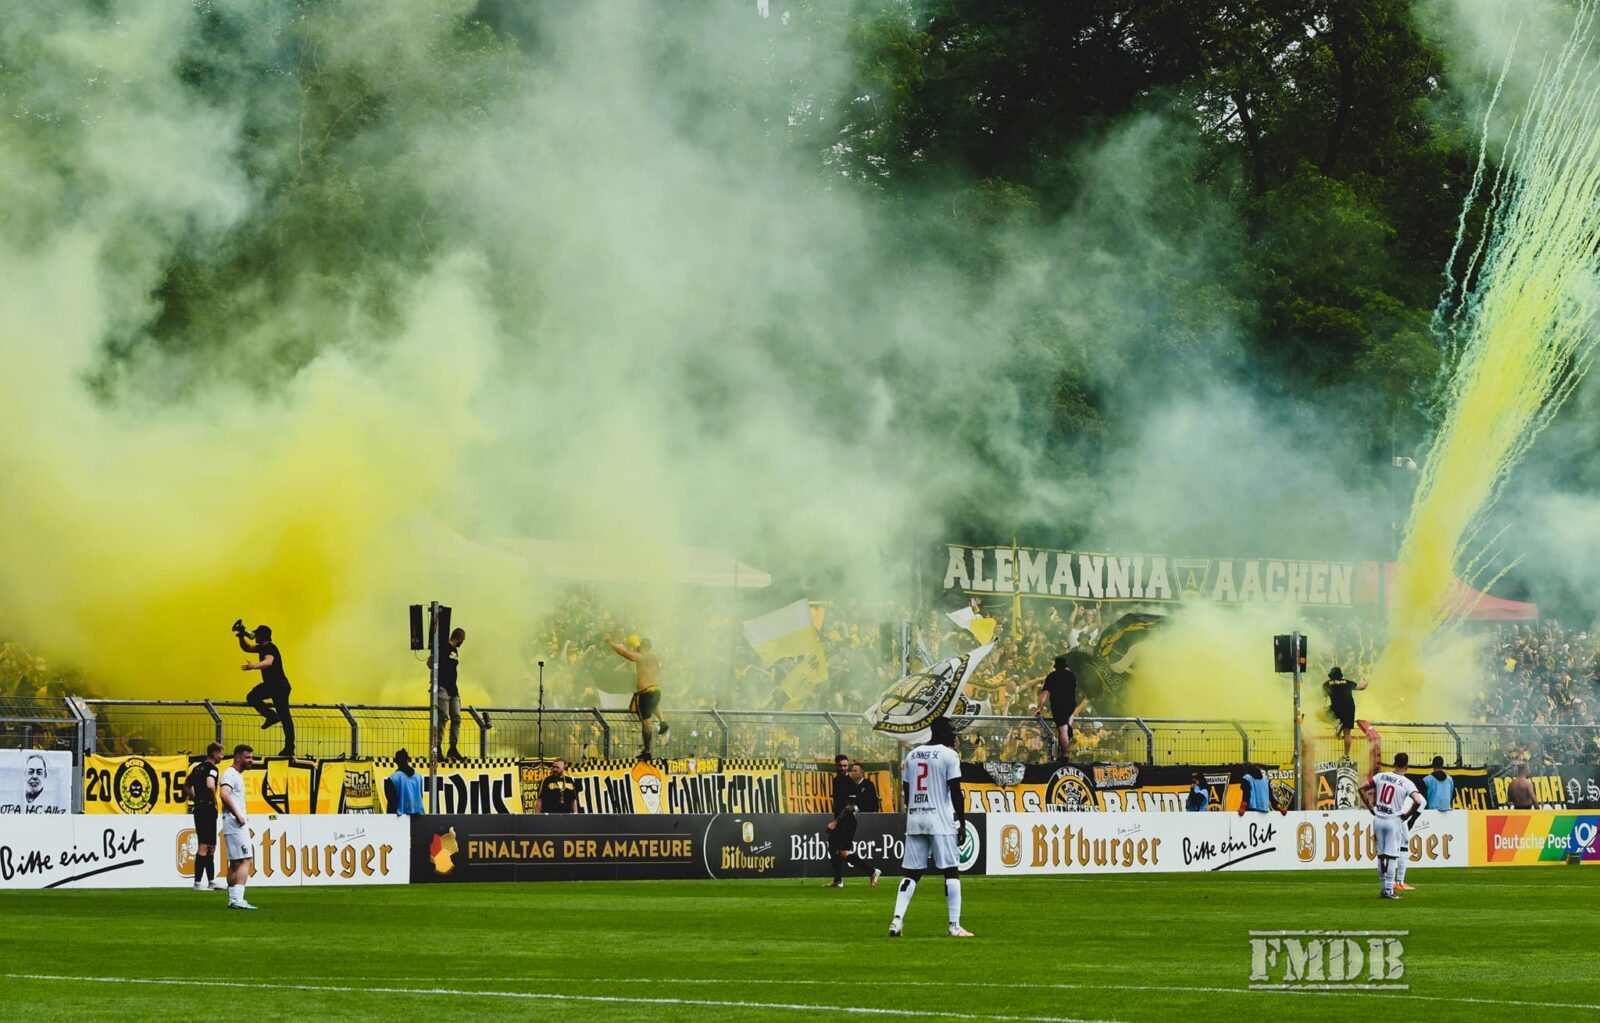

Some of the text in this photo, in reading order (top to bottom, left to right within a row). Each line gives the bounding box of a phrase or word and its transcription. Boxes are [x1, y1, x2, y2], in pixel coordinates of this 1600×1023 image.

[943, 546, 1354, 605] ALEMANNIA AACHEN
[86, 768, 111, 801] 20
[161, 771, 187, 804] 15
[917, 763, 928, 790] 2
[1318, 776, 1333, 799] A
[960, 790, 1041, 812] ARLS
[1210, 786, 1219, 802] A
[1380, 784, 1395, 805] 10
[1453, 787, 1487, 810] ACHT
[1, 829, 144, 880] Bitte ein Bit
[468, 840, 692, 858] FINALTAG DER AMATEURE
[1030, 824, 1161, 867] Bitburger
[1183, 823, 1276, 865] Bitte ein Bit
[1324, 821, 1453, 862] Bitbger
[1494, 834, 1571, 849] Deutsche Post
[721, 846, 775, 872] Bitburger
